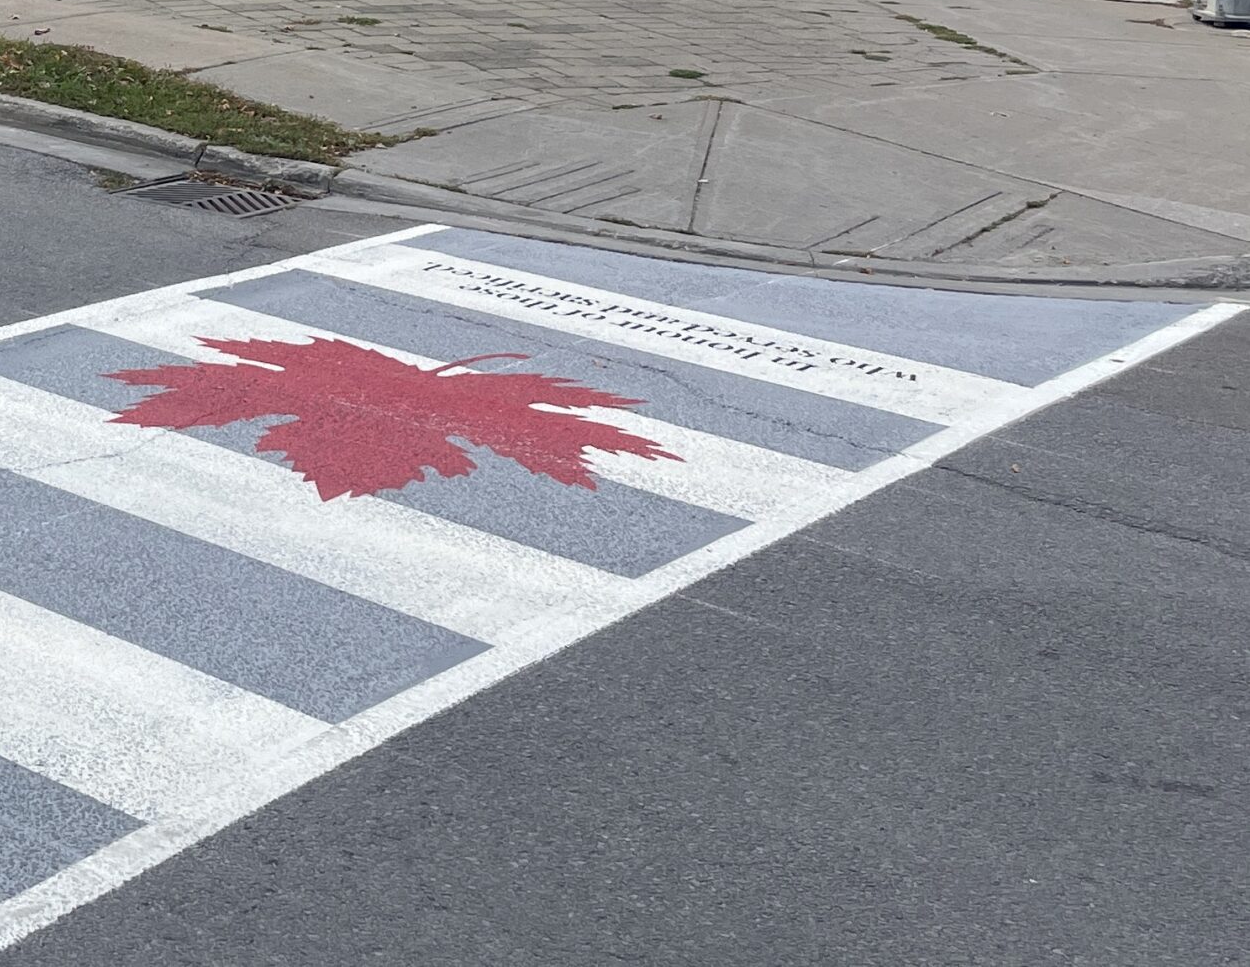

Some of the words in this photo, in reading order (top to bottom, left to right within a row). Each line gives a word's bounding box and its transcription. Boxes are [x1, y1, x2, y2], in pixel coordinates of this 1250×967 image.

[421, 261, 601, 307] sacrificed.
[458, 285, 559, 311] those
[552, 309, 607, 322] of
[599, 304, 681, 325] and
[609, 320, 762, 360] honour
[681, 323, 822, 358] served
[771, 356, 818, 372] In
[829, 357, 917, 382] who
